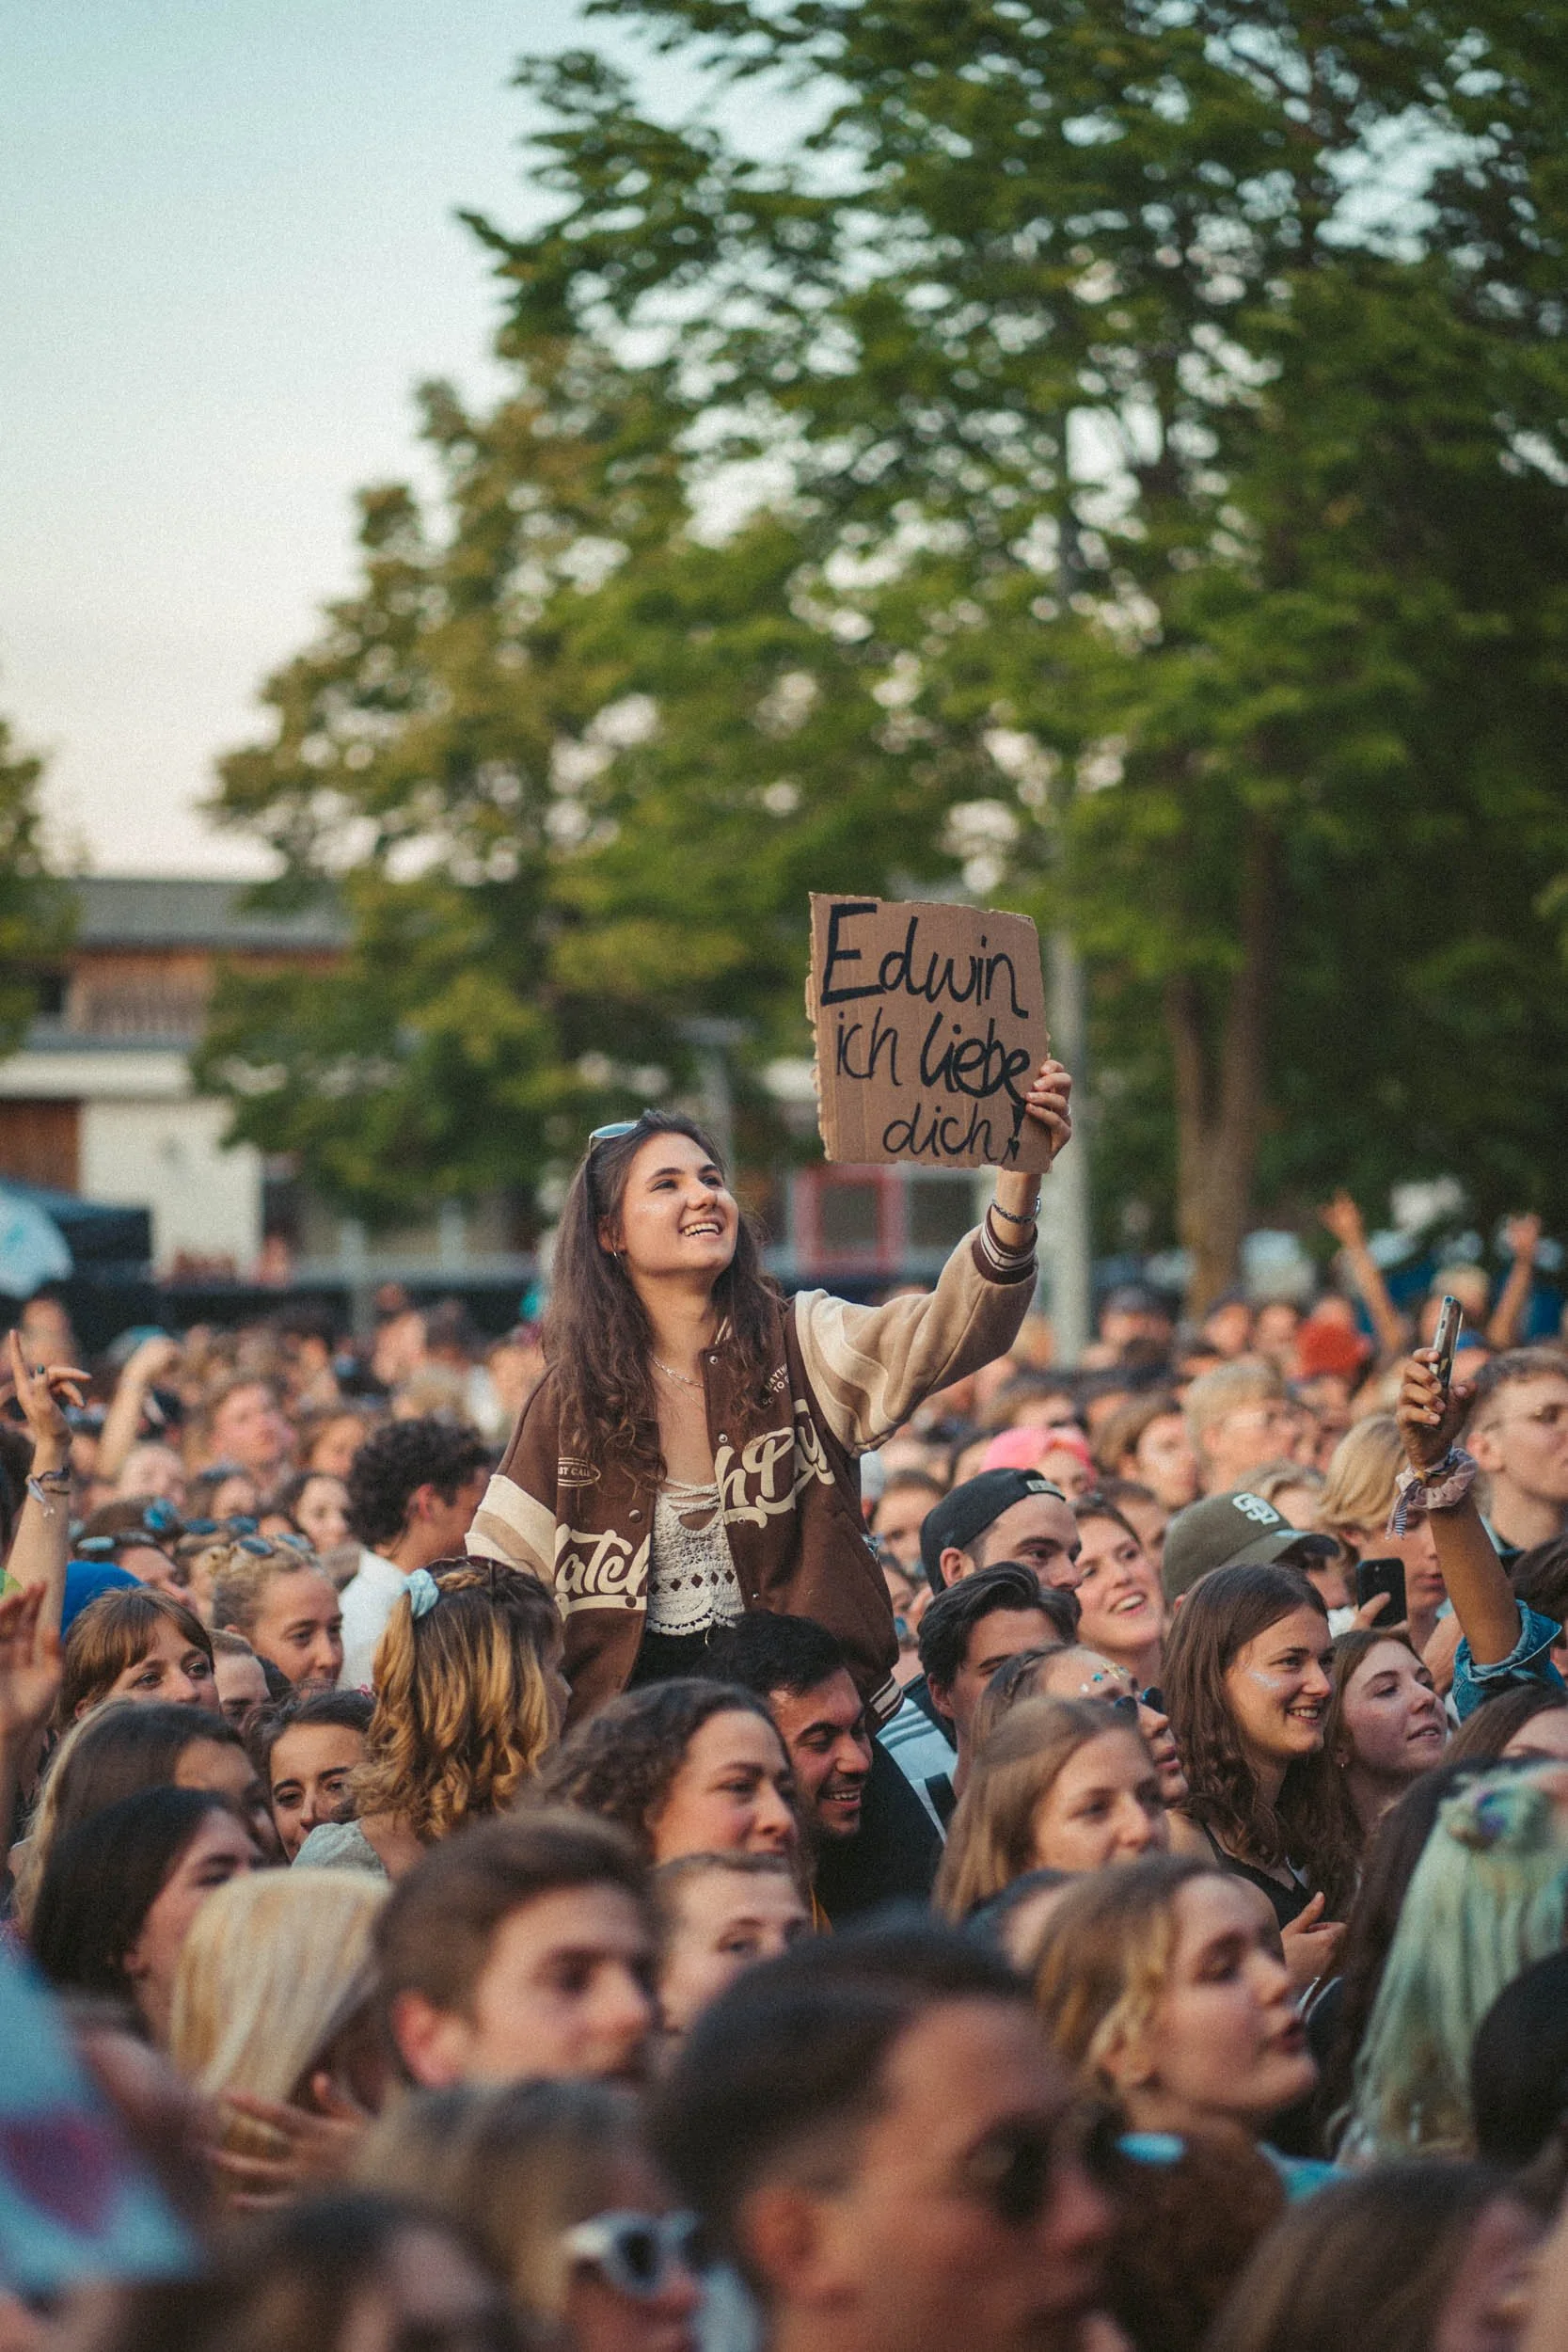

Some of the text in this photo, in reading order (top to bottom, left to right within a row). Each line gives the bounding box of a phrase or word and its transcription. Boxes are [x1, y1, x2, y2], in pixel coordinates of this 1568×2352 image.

[820, 902, 1029, 1019] Edwin
[835, 1007, 1031, 1104] ich liebe
